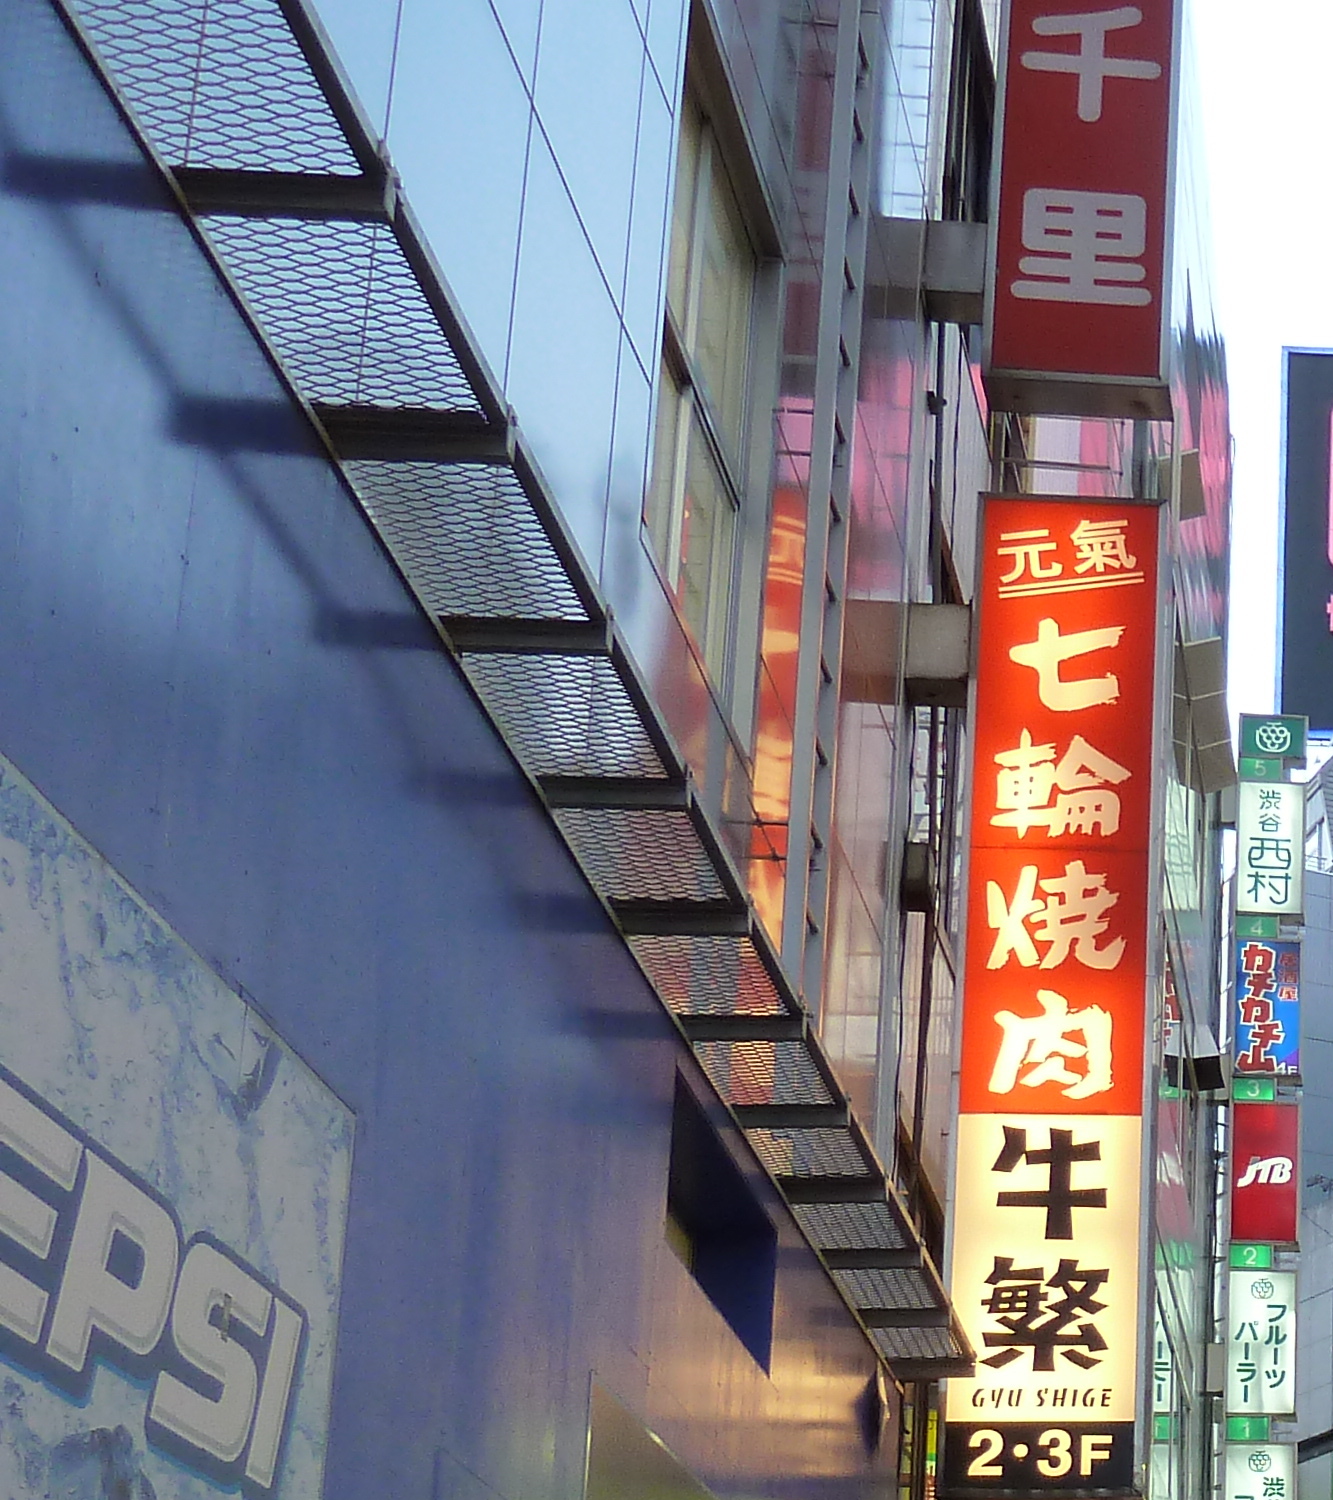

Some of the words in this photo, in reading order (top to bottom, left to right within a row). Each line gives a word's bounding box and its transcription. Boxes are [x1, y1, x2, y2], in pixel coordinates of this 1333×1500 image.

[997, 518, 1138, 586] 元氣
[1253, 761, 1267, 776] 5
[985, 616, 1133, 1100] 七輪焼肉
[1246, 788, 1293, 905] 渋谷西村
[1249, 920, 1264, 936] 4
[1278, 952, 1299, 1001] 居酒屋
[1236, 942, 1285, 1074] カチカチ山
[1246, 1079, 1261, 1097] 3
[1237, 1156, 1294, 1188] JTB
[979, 1125, 1110, 1374] 牛繁
[1243, 1247, 1258, 1266] 2
[1234, 1321, 1260, 1403] パーラー
[1265, 1304, 1288, 1389] フルーツ
[971, 1387, 1024, 1408] GYU
[1035, 1387, 1114, 1408] SHIGE
[1243, 1423, 1251, 1438] 1
